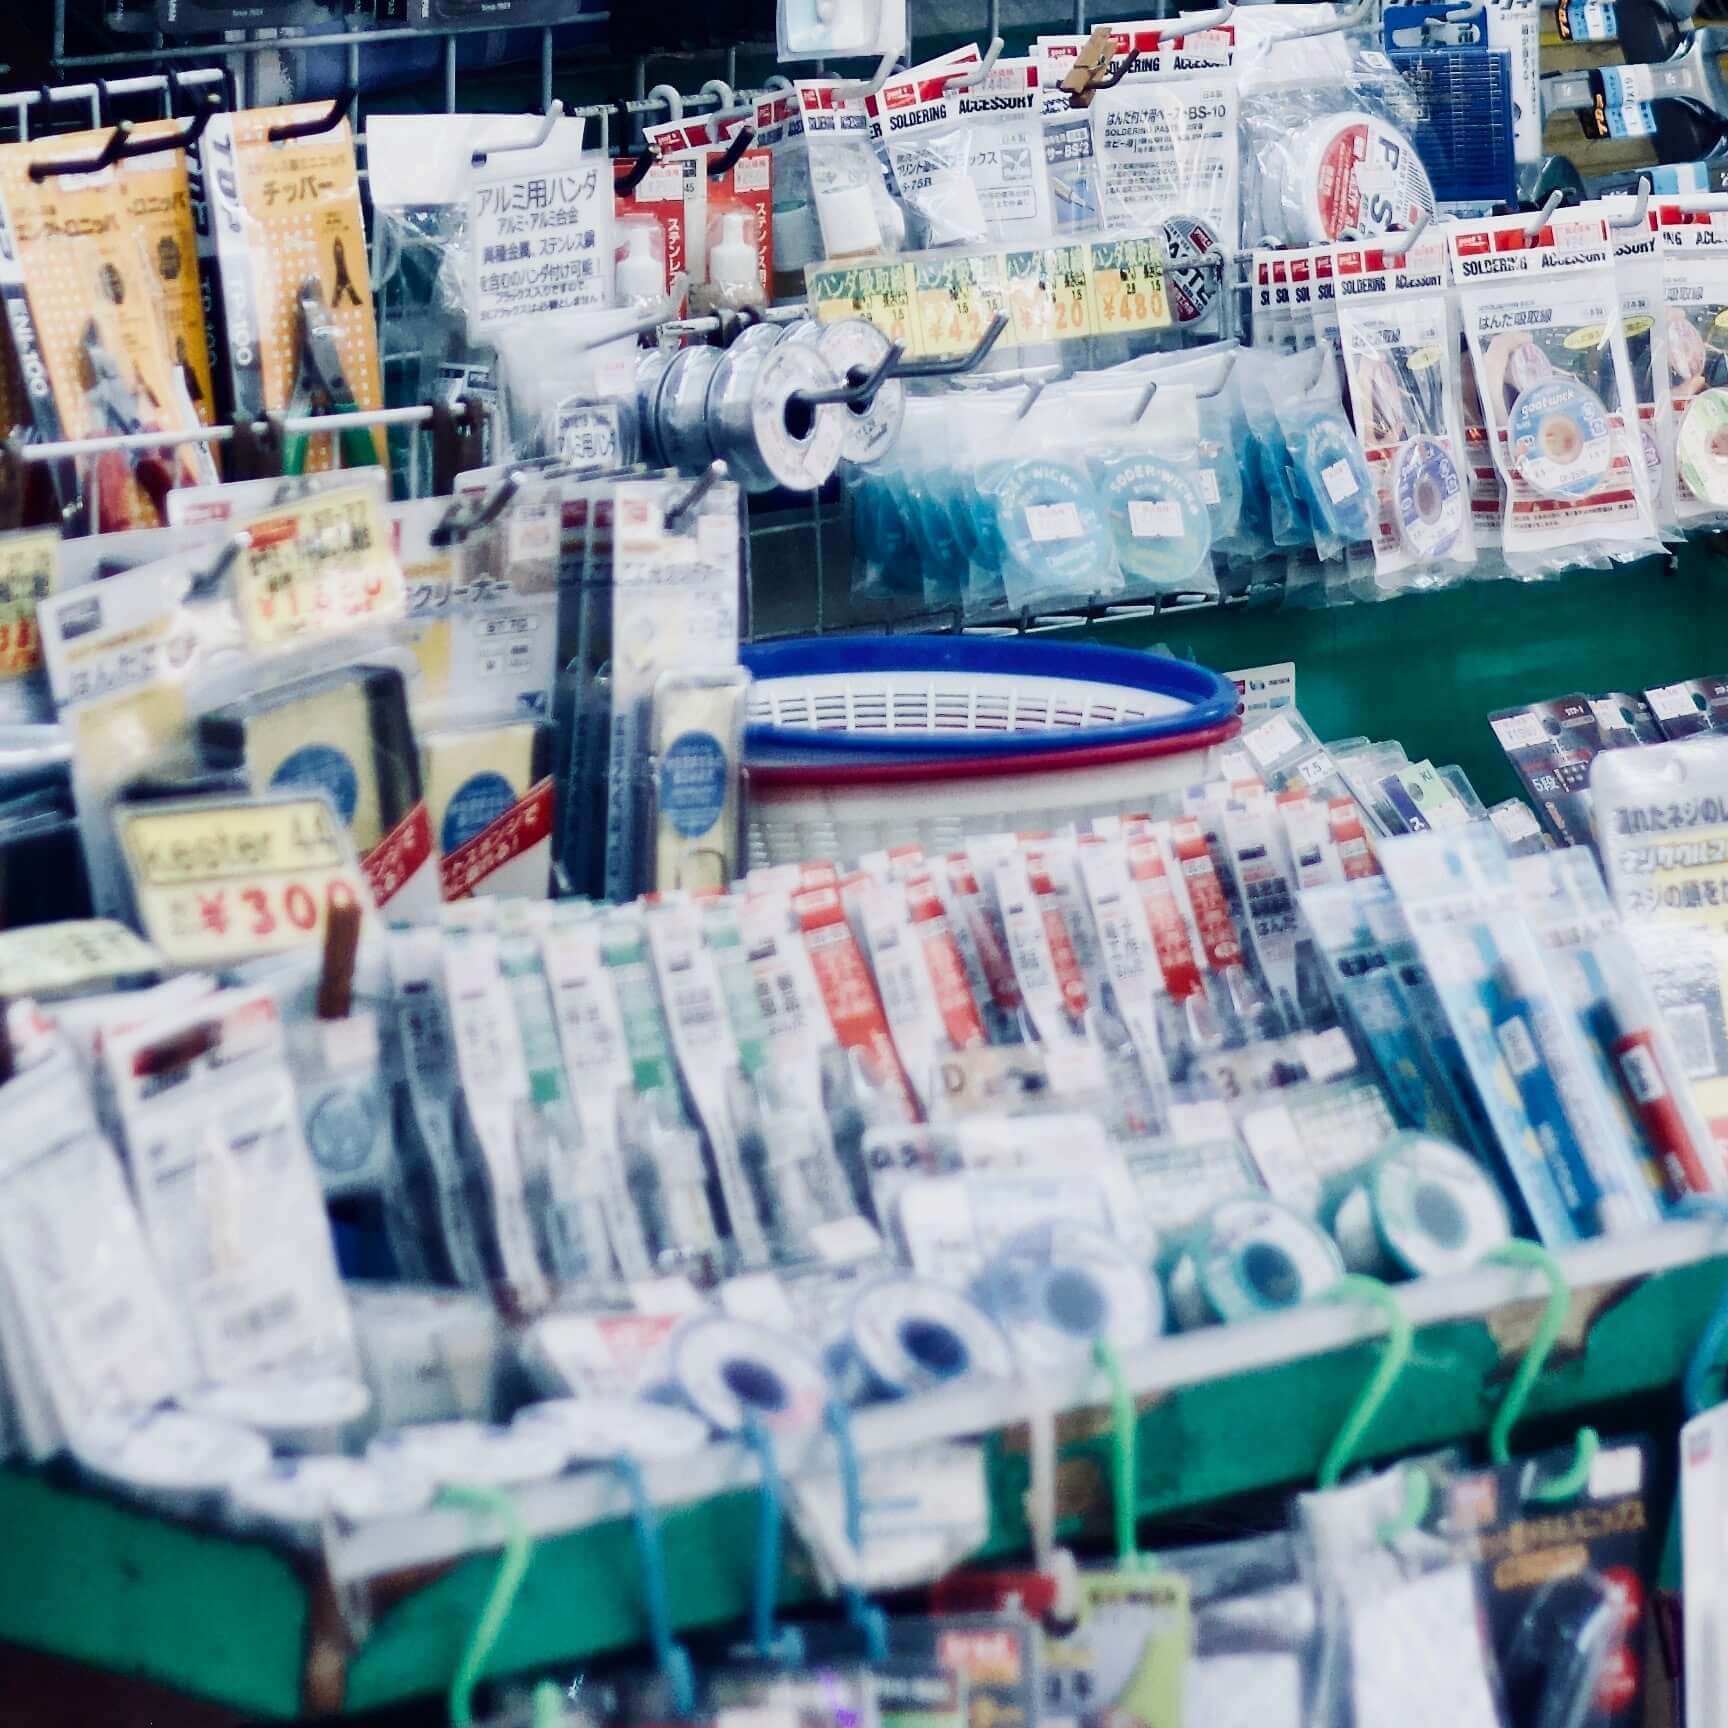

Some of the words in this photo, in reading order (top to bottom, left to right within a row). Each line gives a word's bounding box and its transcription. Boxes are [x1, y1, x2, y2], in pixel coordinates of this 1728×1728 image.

[889, 104, 948, 130] SOLDERING
[958, 93, 1035, 115] ACCESSORY
[261, 174, 336, 203] チッパー
[476, 168, 599, 216] アルミ用ハンダ
[1342, 275, 1386, 296] SOLDERING
